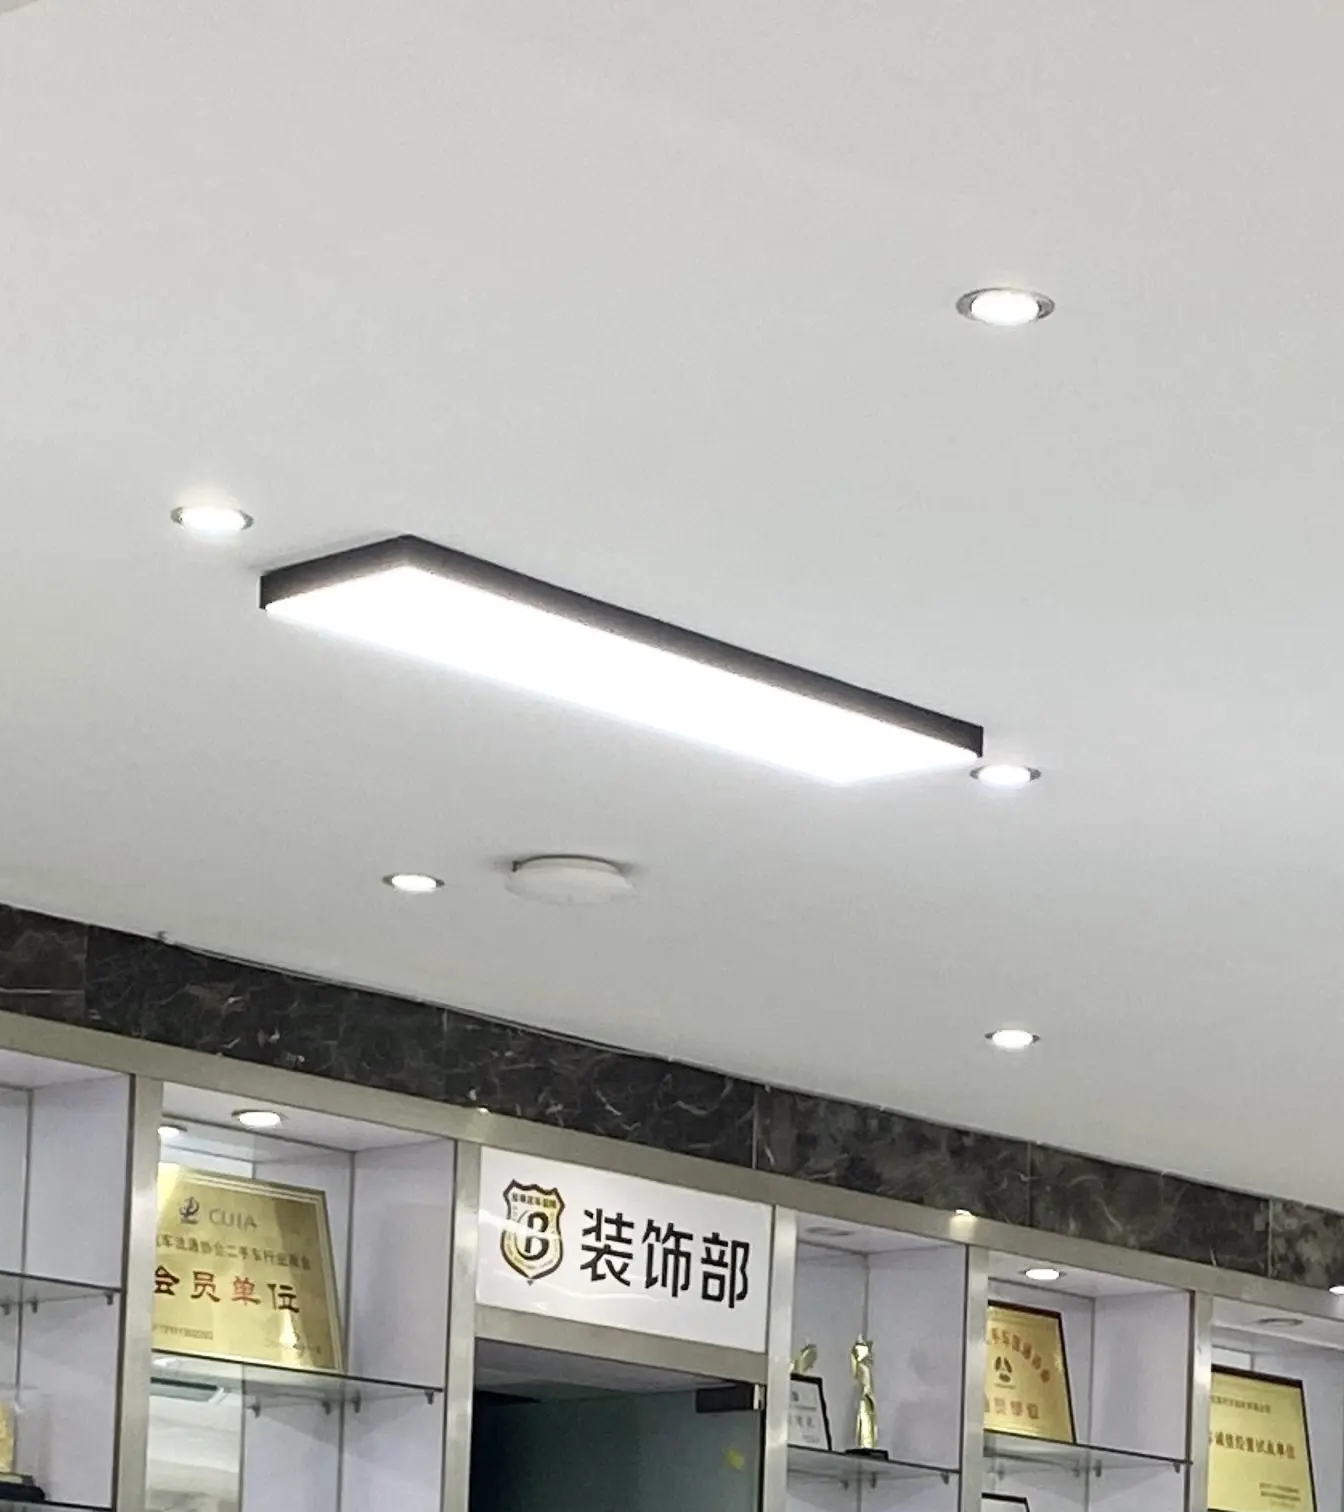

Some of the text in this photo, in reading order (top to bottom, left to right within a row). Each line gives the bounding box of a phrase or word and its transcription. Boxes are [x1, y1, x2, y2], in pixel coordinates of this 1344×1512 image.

[154, 1265, 299, 1313] 会员单位
[580, 1208, 750, 1308] 装饰部
